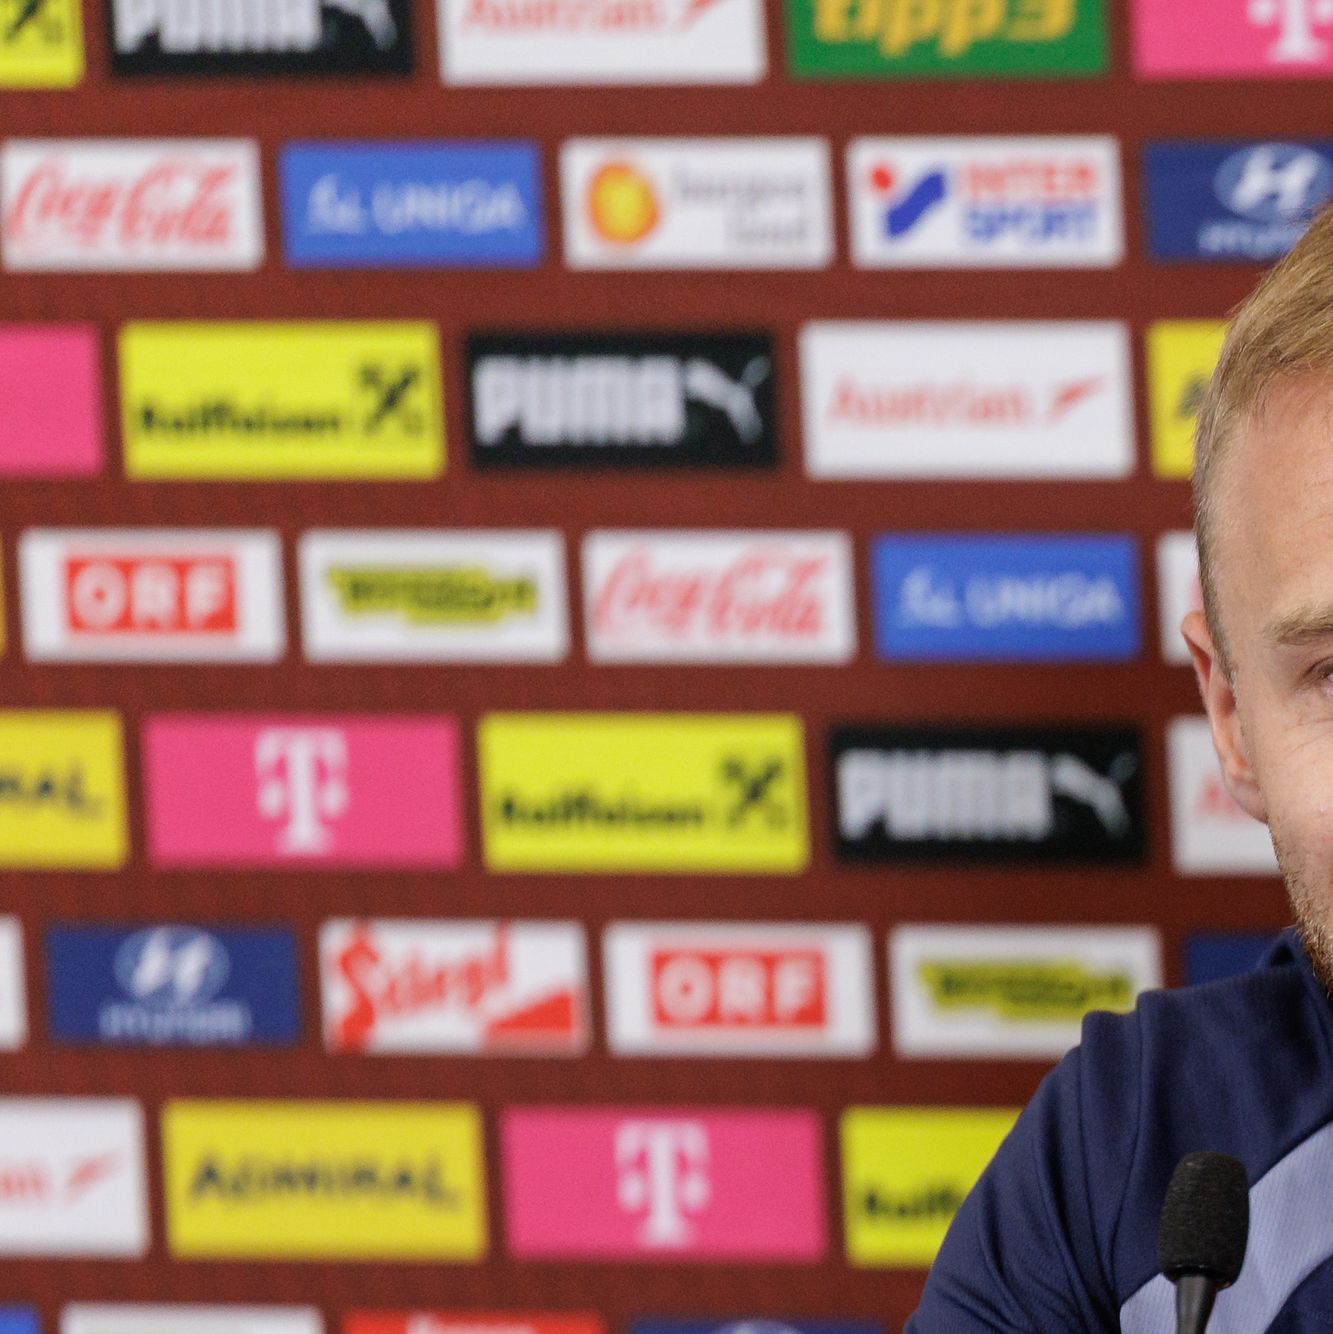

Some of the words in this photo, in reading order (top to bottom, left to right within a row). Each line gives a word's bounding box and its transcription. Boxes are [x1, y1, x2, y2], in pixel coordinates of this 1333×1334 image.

[472, 356, 688, 446] PUMA
[71, 562, 233, 629] ORF
[837, 750, 1056, 839] PUMA
[657, 954, 822, 1024] ORF
